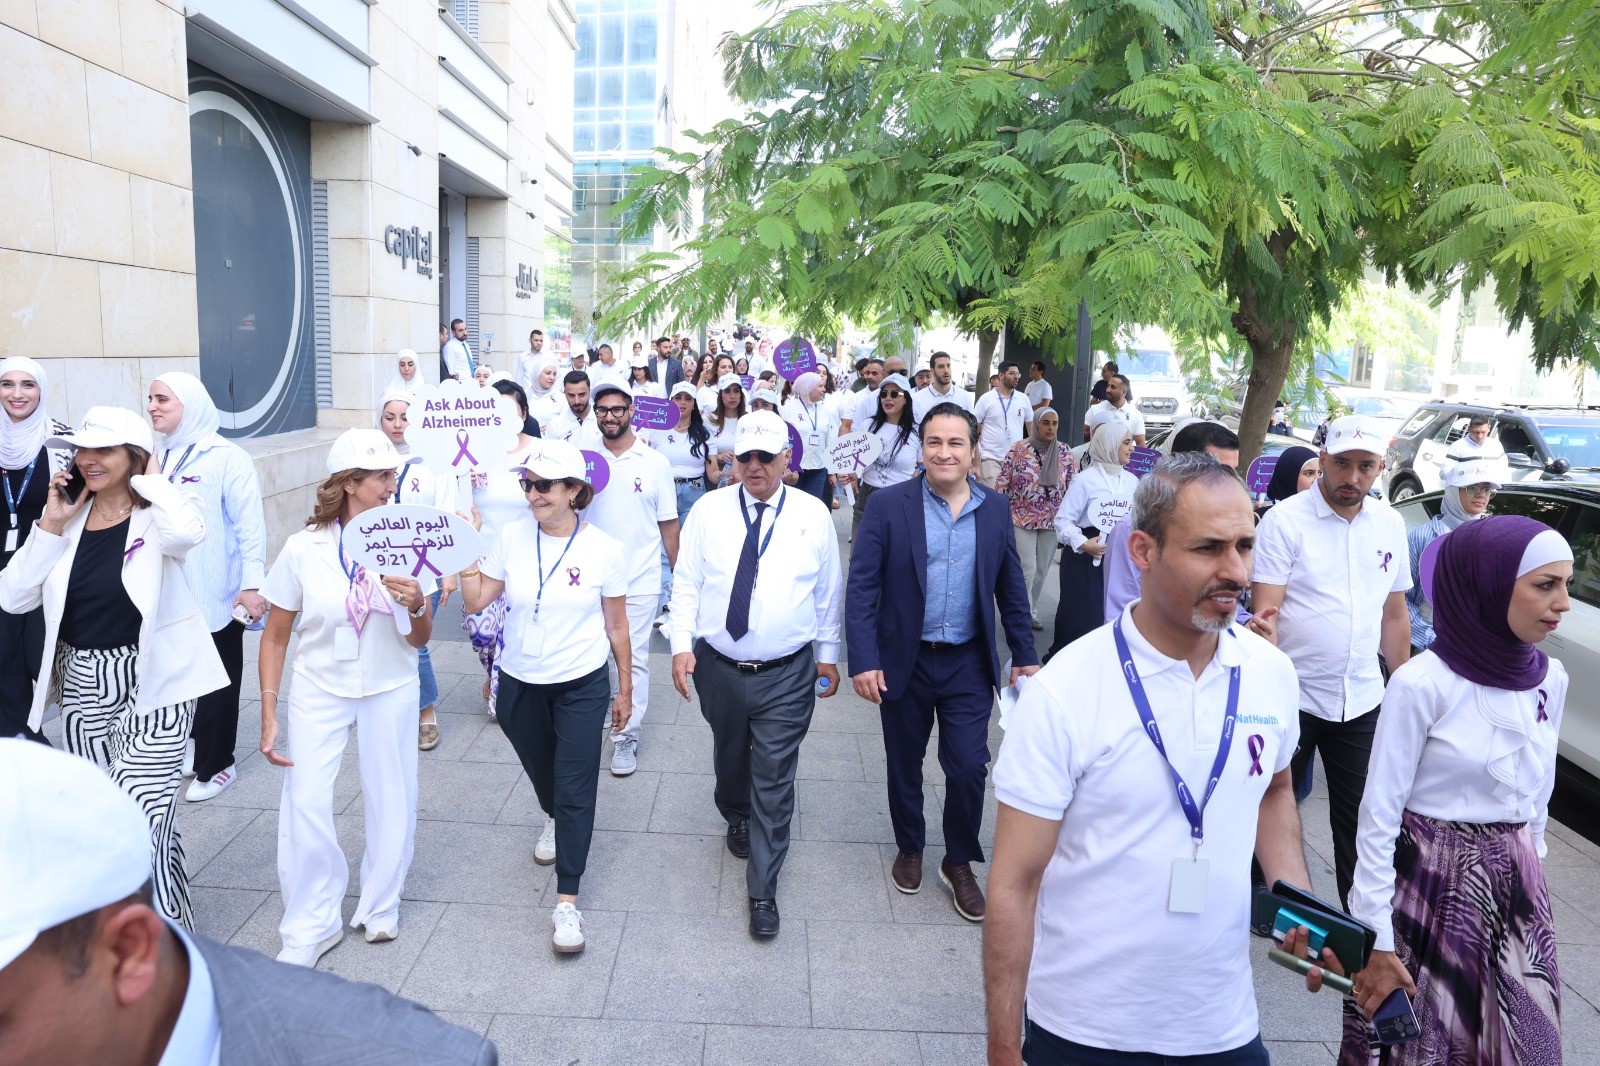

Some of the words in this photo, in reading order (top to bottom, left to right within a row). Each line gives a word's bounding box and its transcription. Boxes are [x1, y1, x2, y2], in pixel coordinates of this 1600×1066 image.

[385, 224, 432, 270] capital
[424, 398, 451, 411] Ask
[454, 397, 496, 411] About
[421, 413, 502, 429] Alzheimer's
[829, 440, 851, 457] العالمي
[853, 434, 868, 448] اليوم
[1129, 456, 1155, 467] رعاي
[1100, 499, 1128, 510] العالمي
[359, 517, 411, 538] العالمي
[415, 515, 450, 535] اليوم
[364, 534, 454, 552] للزهايمر
[1236, 713, 1279, 725] NatHealth
